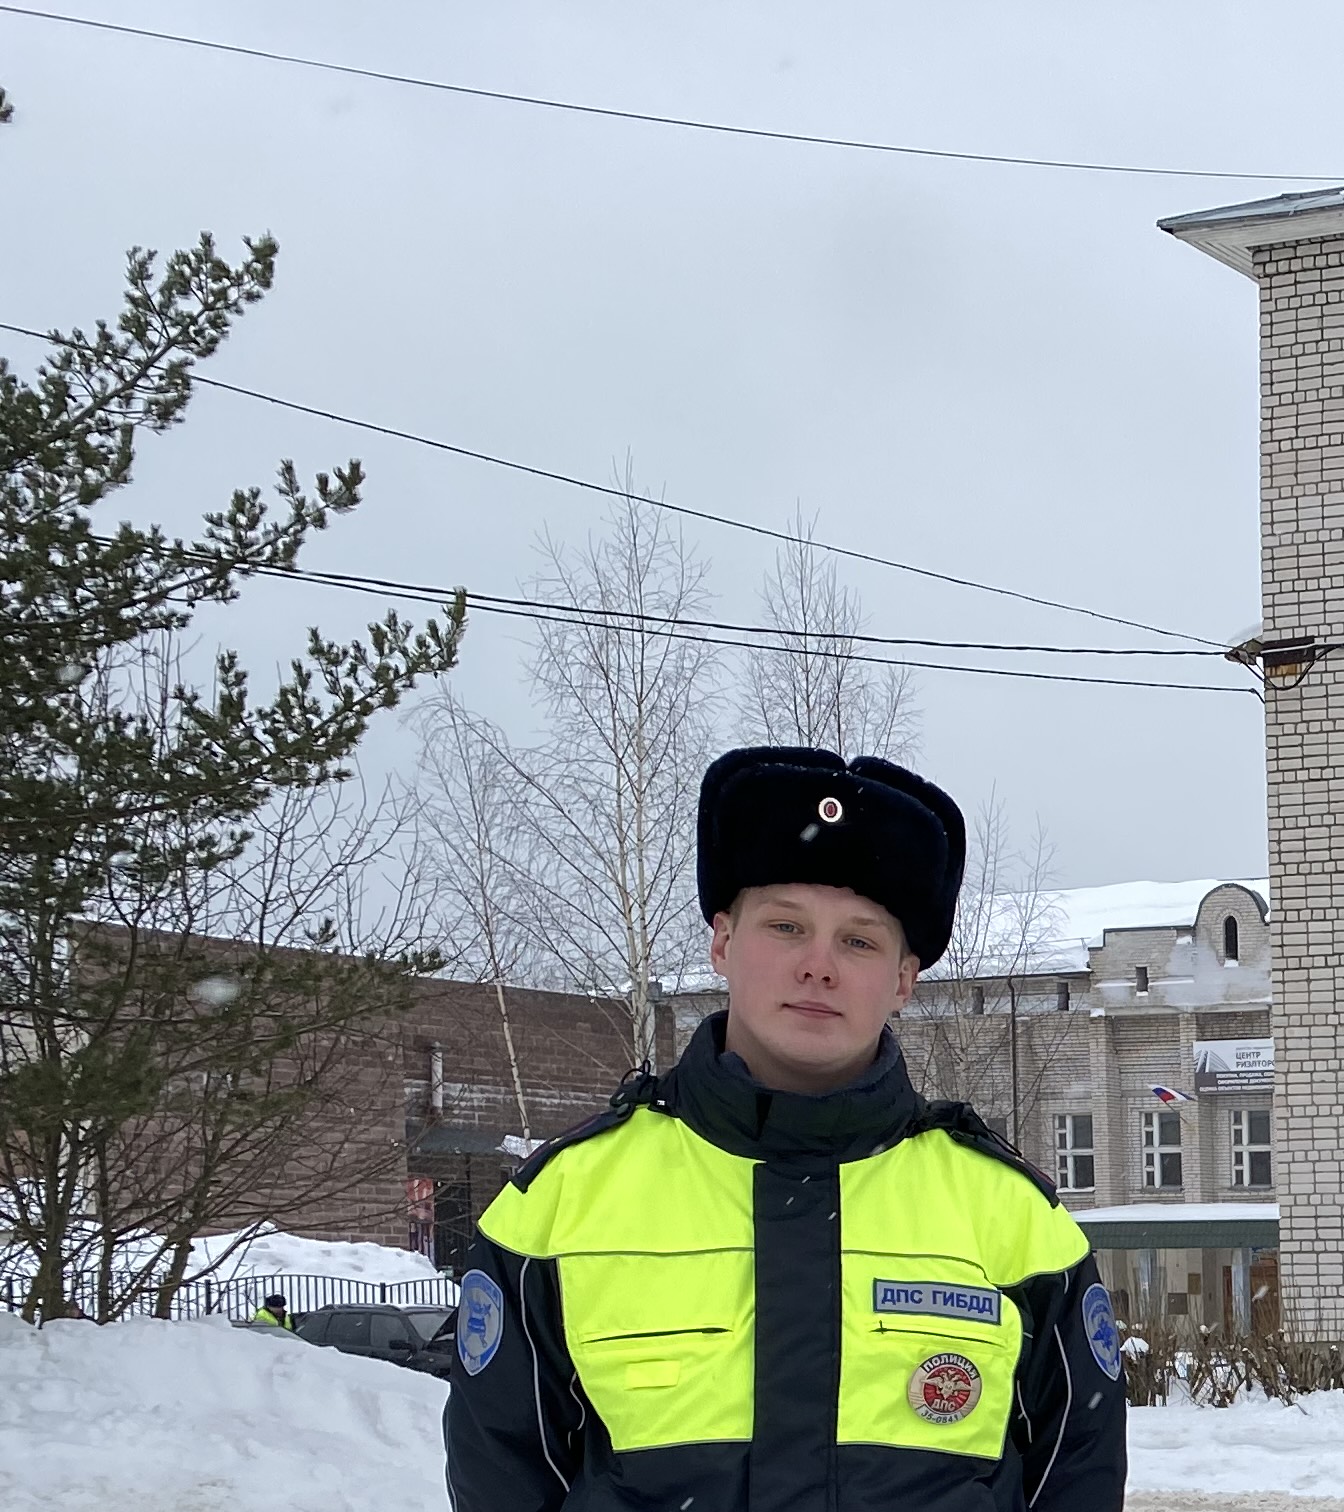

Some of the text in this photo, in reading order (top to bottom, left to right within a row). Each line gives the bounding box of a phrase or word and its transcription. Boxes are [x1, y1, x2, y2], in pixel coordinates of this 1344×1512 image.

[1236, 1052, 1261, 1060] ЦЕНТР
[881, 1288, 993, 1315] ДПС ГИБДД
[923, 1354, 977, 1379] ПОЛИЦИЯ
[931, 1399, 956, 1411] ДПС
